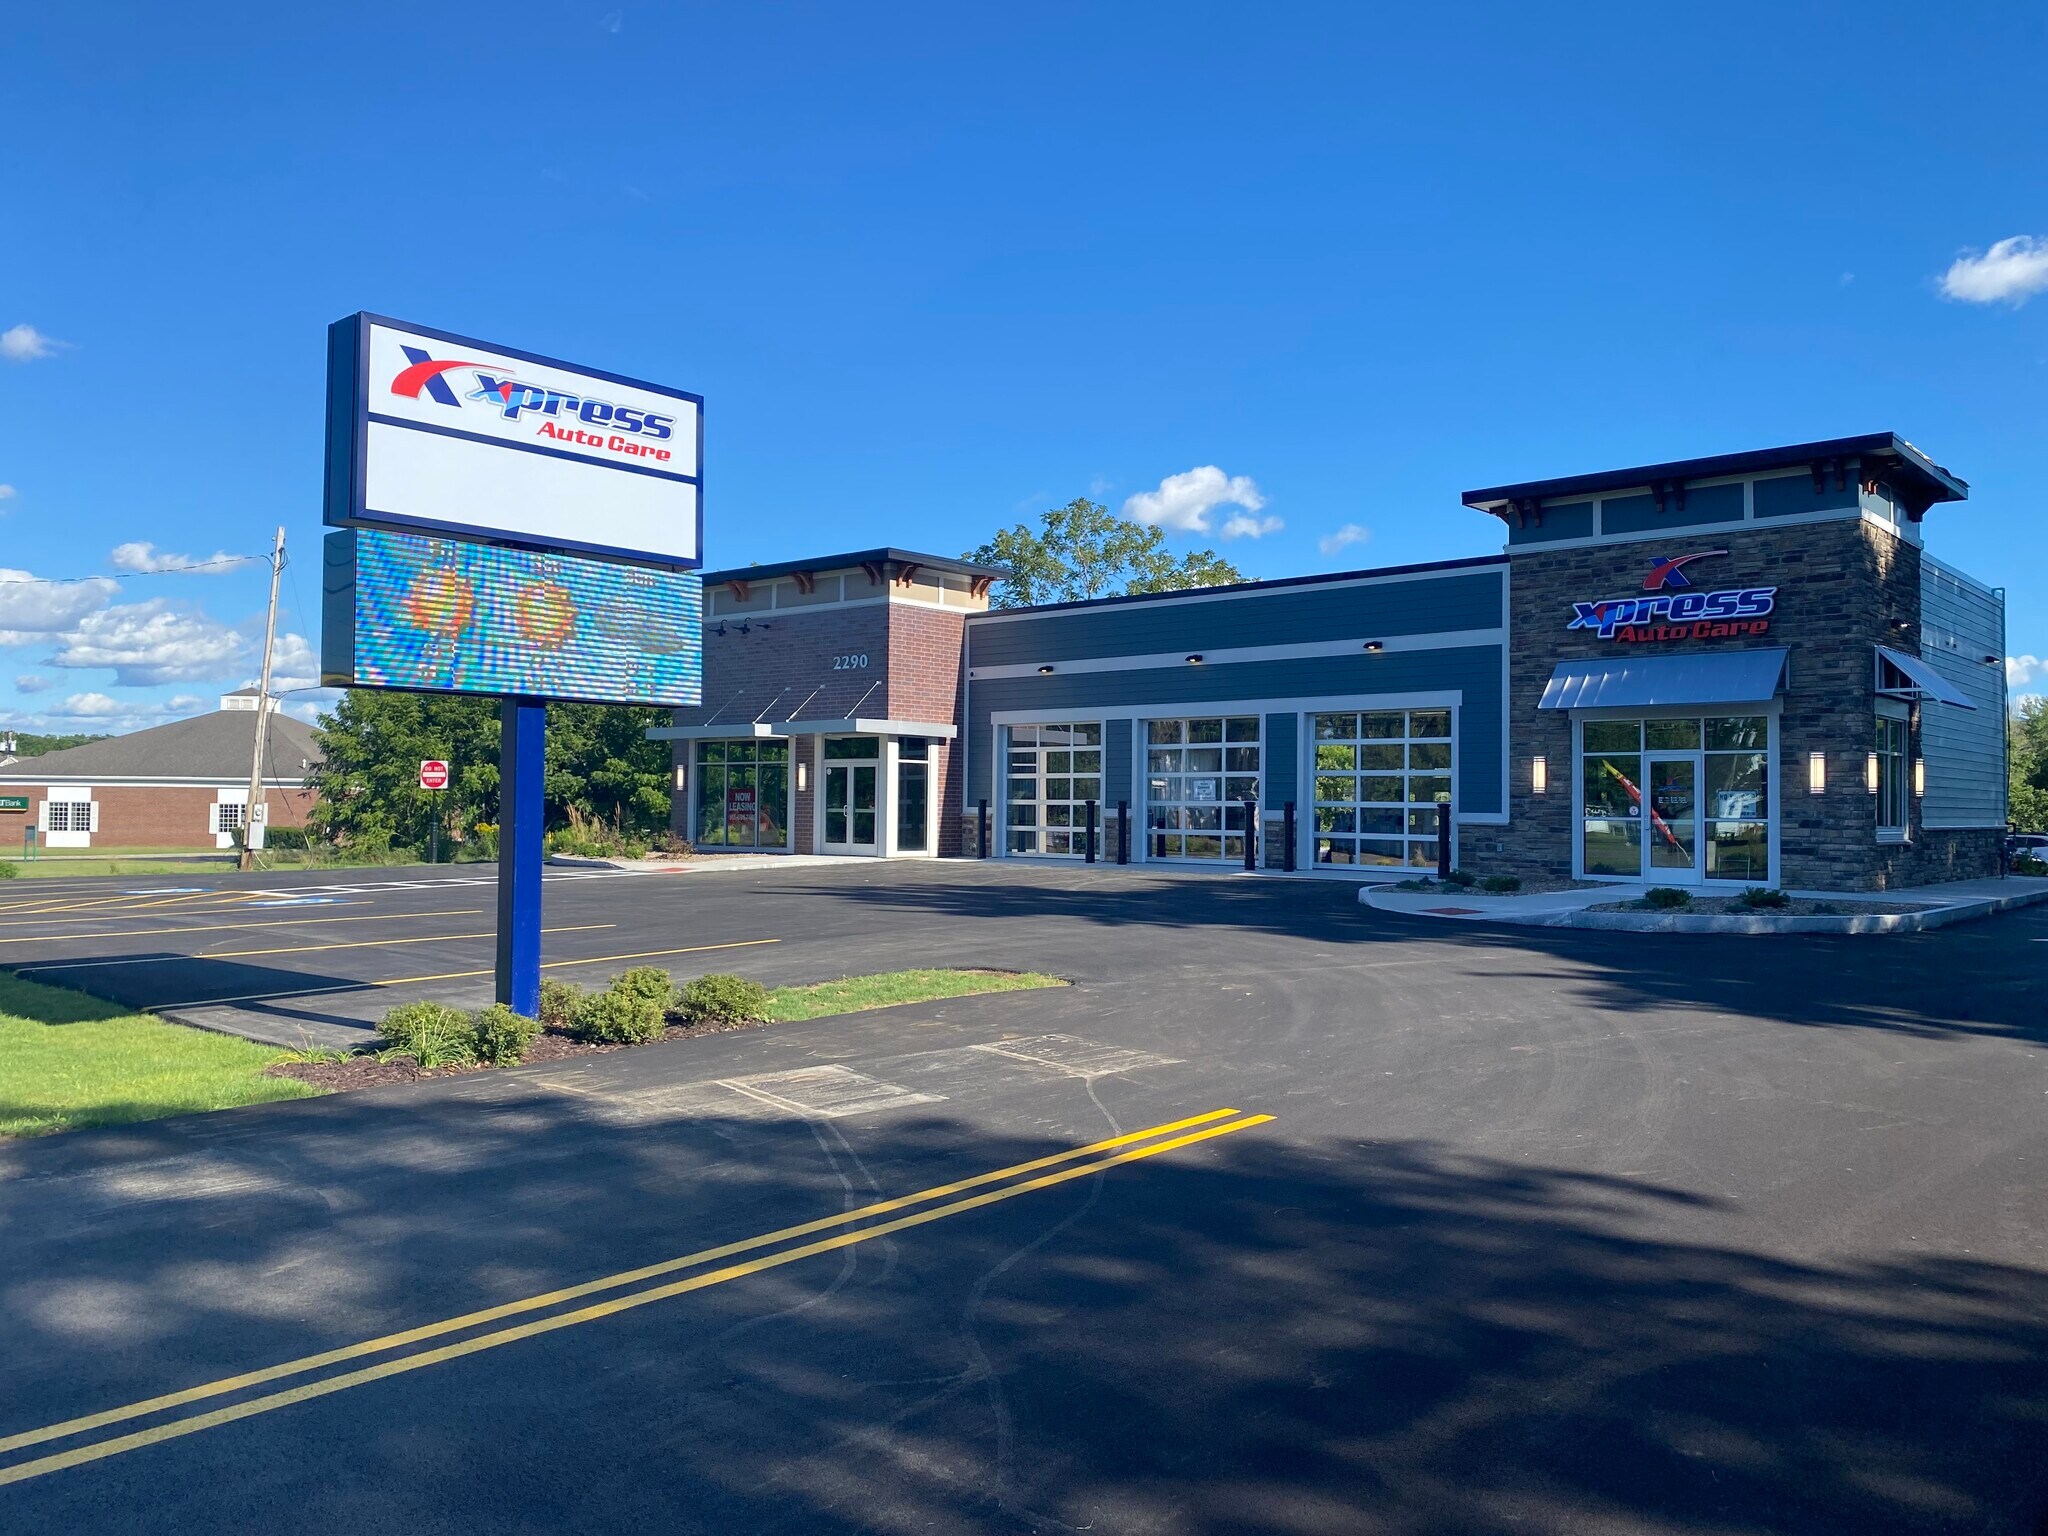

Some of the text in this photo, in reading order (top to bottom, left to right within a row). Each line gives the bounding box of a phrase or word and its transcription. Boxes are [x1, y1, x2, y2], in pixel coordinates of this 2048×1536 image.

[537, 421, 671, 462] Auto Care
[1616, 620, 1769, 643] Auto Care
[833, 654, 868, 670] 2290
[735, 792, 751, 801] NOW
[729, 802, 756, 811] LEASING
